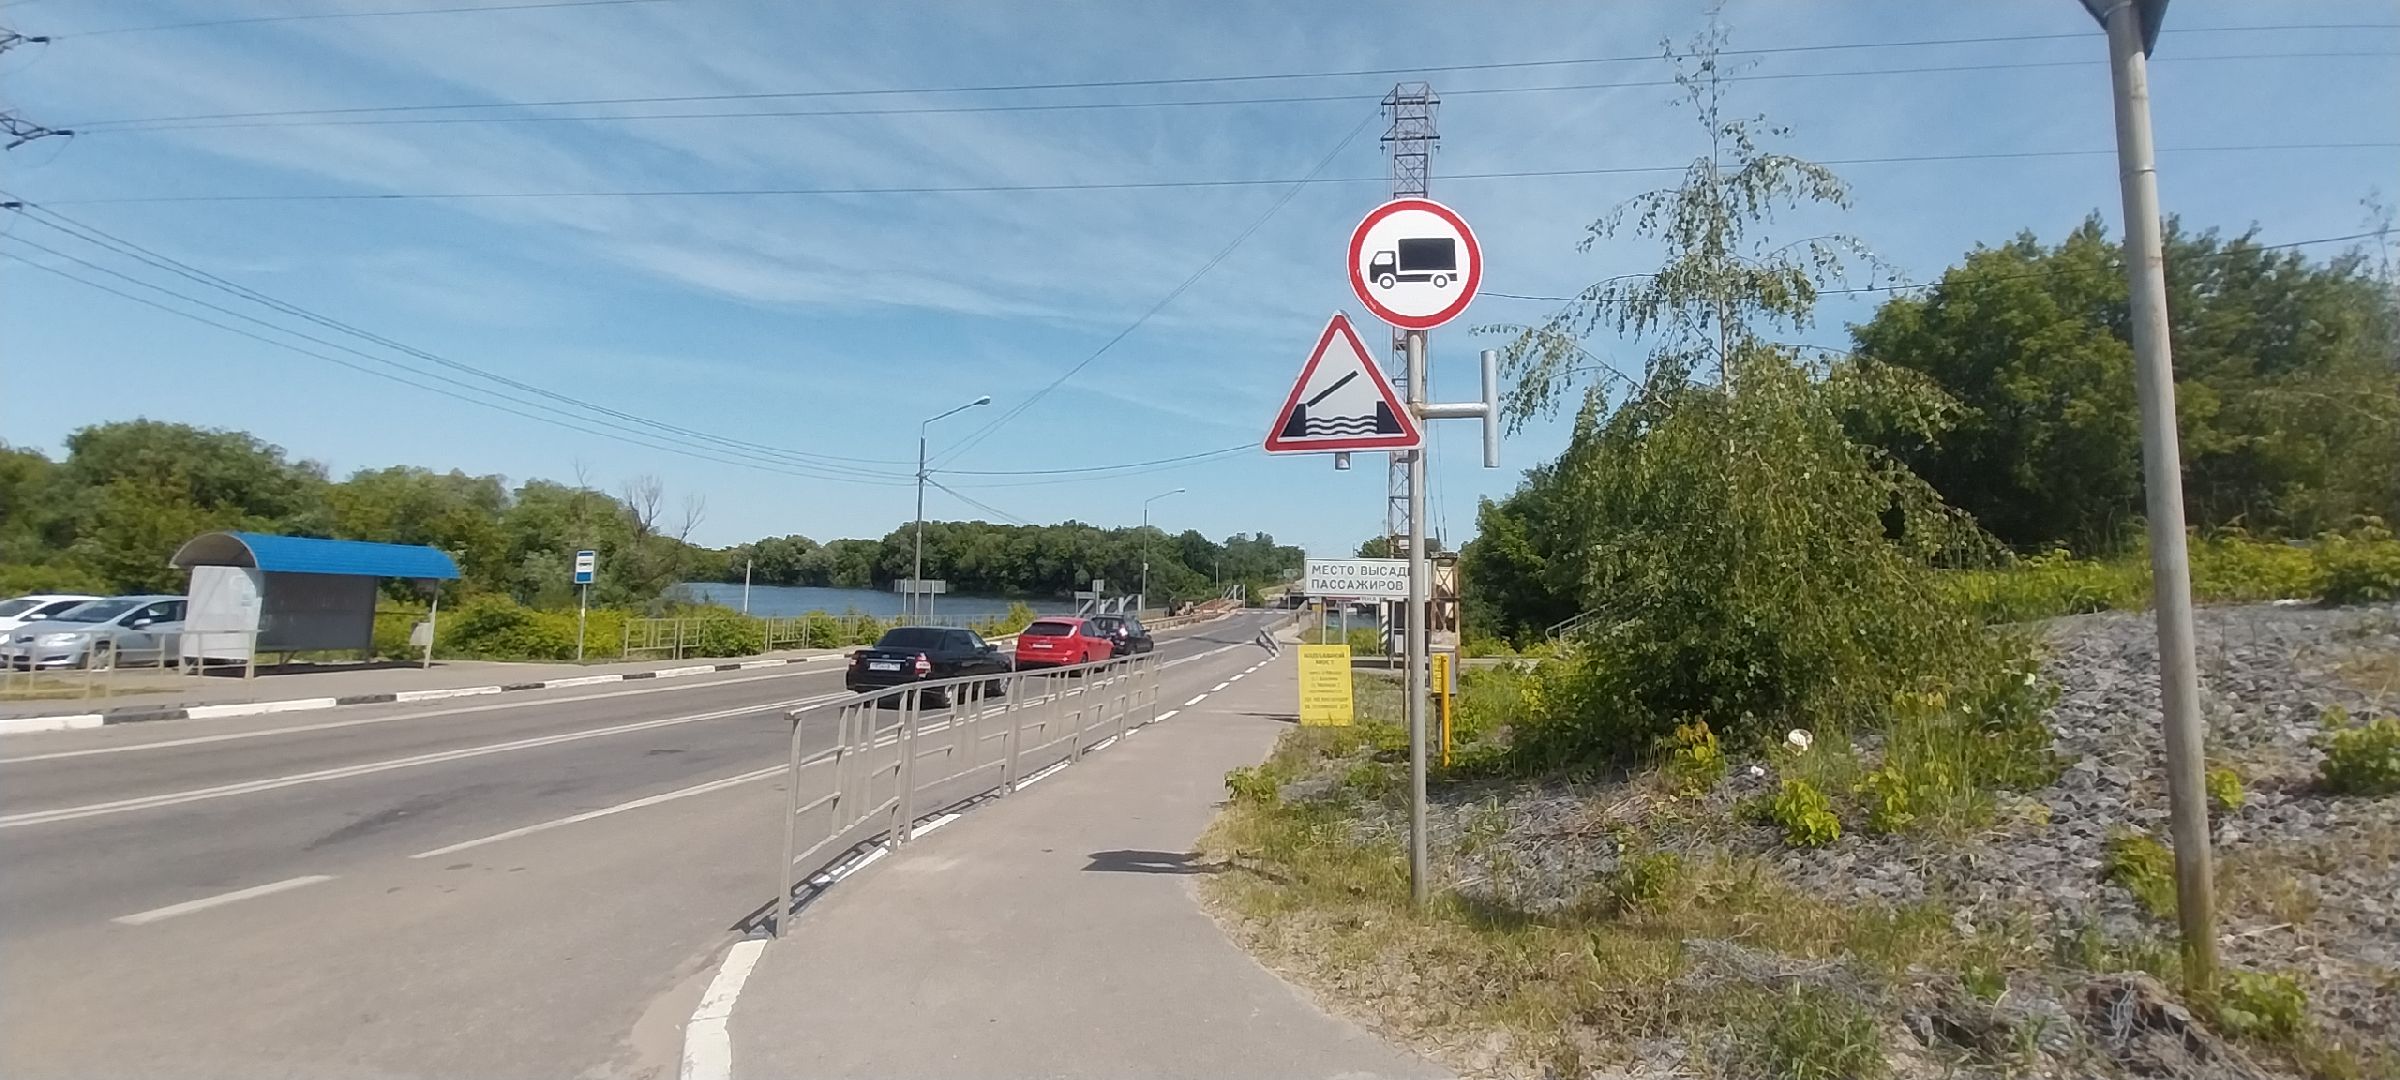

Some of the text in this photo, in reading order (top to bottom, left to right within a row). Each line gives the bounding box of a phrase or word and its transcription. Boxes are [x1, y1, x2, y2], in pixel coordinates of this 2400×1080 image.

[1311, 565, 1411, 577] МЕСТО ВЫСАД
[1311, 579, 1404, 591] ПАССАЖИРОВ
